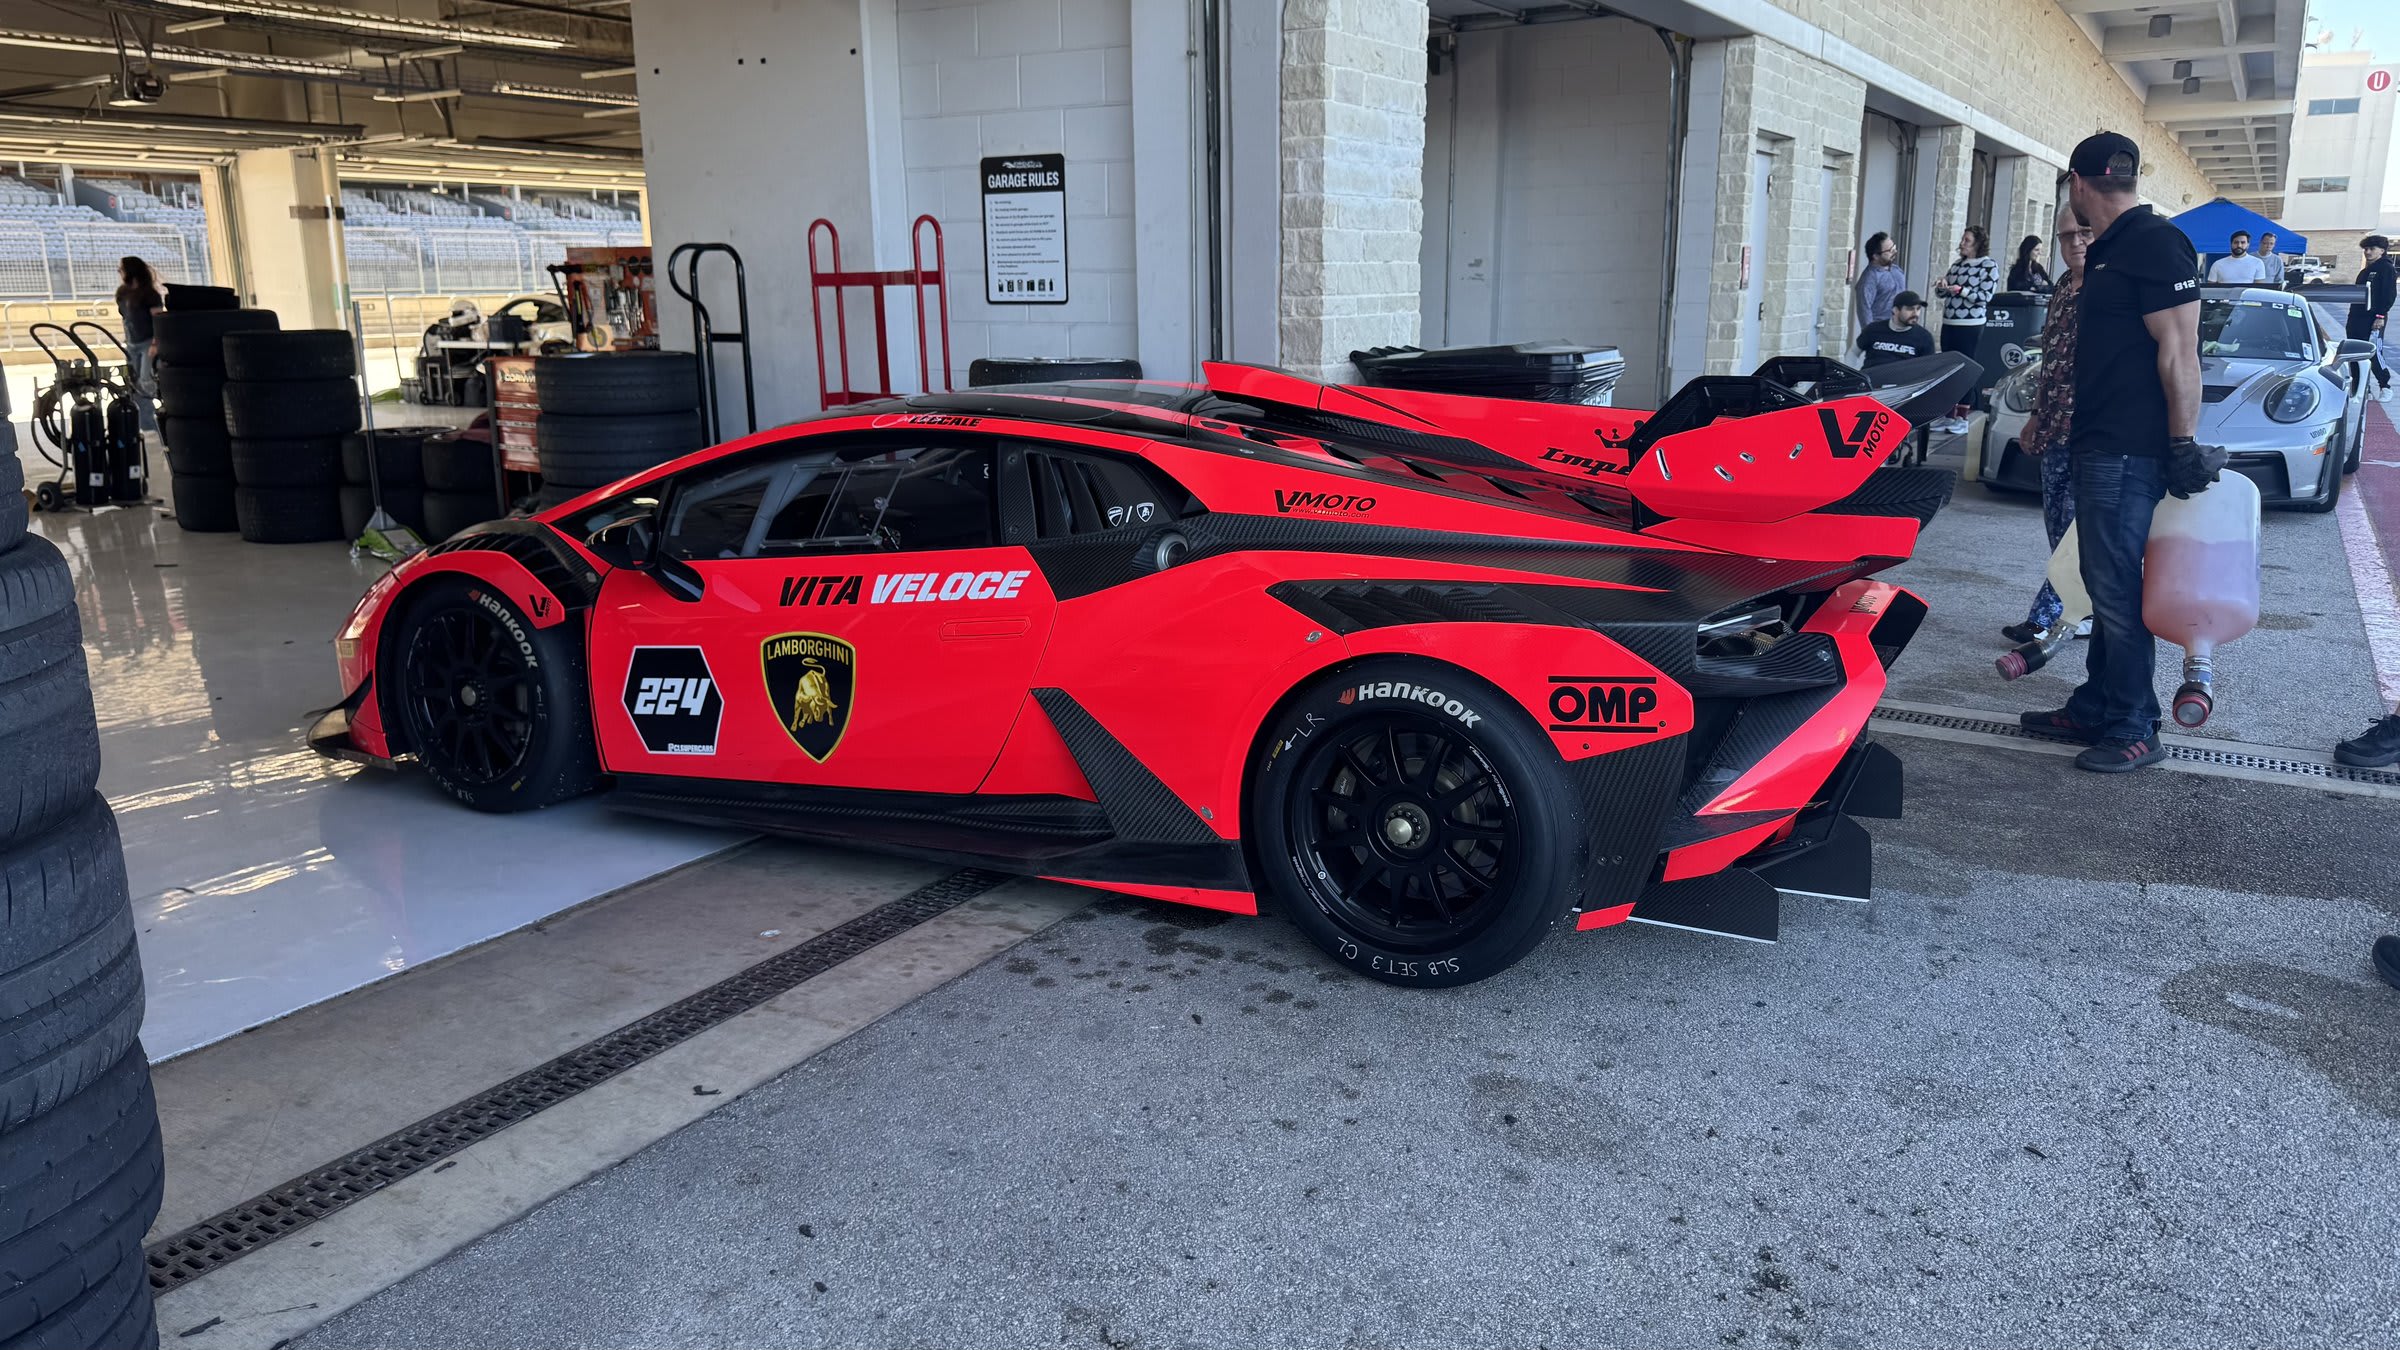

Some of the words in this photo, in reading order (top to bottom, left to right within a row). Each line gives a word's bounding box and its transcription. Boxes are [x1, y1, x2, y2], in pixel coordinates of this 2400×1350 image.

[2373, 72, 2385, 90] U
[988, 173, 1027, 189] GARAGE
[1028, 171, 1060, 187] RULES
[1872, 341, 1916, 355] GRIDLIFE
[1862, 411, 1890, 459] MOTO
[778, 575, 864, 607] VITA
[870, 570, 1031, 605] VELOCE
[766, 639, 850, 666] LAMBORGHINI
[634, 677, 711, 716] 224
[1548, 686, 1657, 724] OMP
[1296, 712, 1326, 738] LR
[1337, 936, 1358, 960] CL
